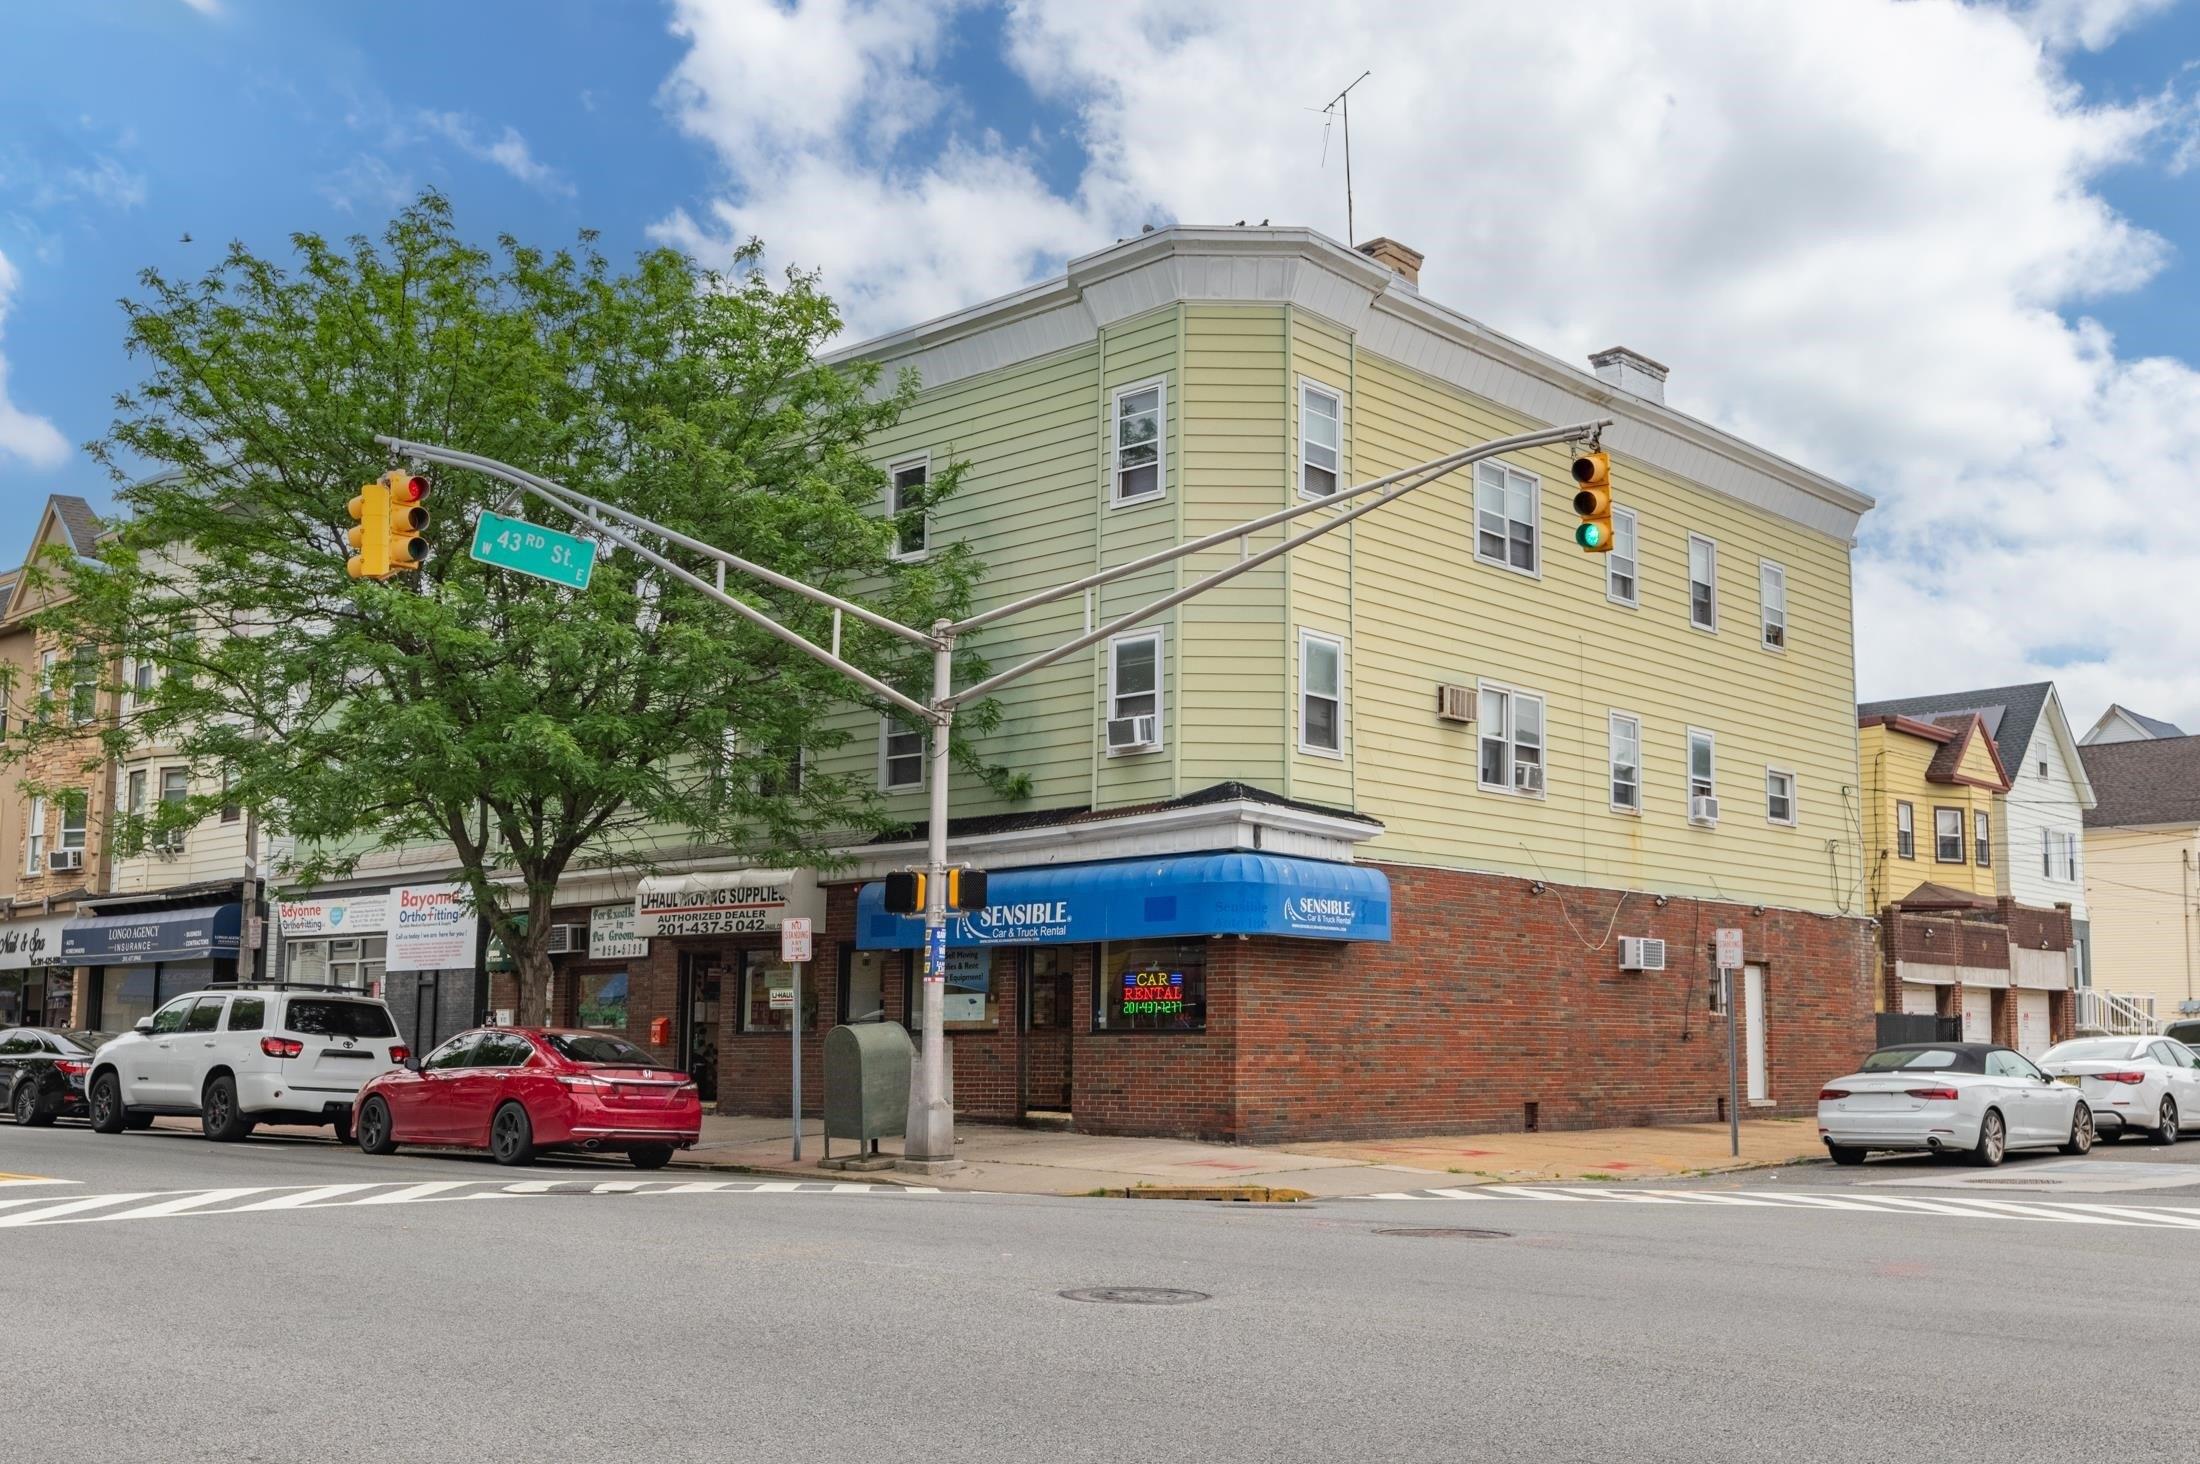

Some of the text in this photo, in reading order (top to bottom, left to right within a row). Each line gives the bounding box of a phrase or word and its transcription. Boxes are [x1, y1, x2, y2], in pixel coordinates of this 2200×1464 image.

[482, 541, 492, 555] W
[551, 544, 573, 568] St.
[575, 568, 584, 582] E
[401, 888, 460, 912] Bayonne
[641, 892, 678, 909] U-HAUL
[1300, 897, 1351, 916] SENSIBLE
[281, 903, 321, 920] Bayonne
[657, 910, 766, 923] AUTHORIZED DEALER
[980, 901, 1067, 927] SENSIBLE
[791, 921, 802, 930] NO
[1307, 914, 1317, 922] Car
[1322, 916, 1336, 924] Truck
[1336, 916, 1352, 925] Rental
[108, 925, 160, 940] LONGO AGENCY
[657, 919, 765, 936] 201-437-5042
[992, 925, 1066, 938] Car & Truck Rental
[20, 932, 28, 952] &
[785, 930, 808, 940] STANDING
[114, 941, 152, 952] INSURANCE
[1136, 973, 1169, 986] CAR
[1123, 987, 1182, 1000] RENTAL
[1123, 1001, 1182, 1014] 201-437-7277
